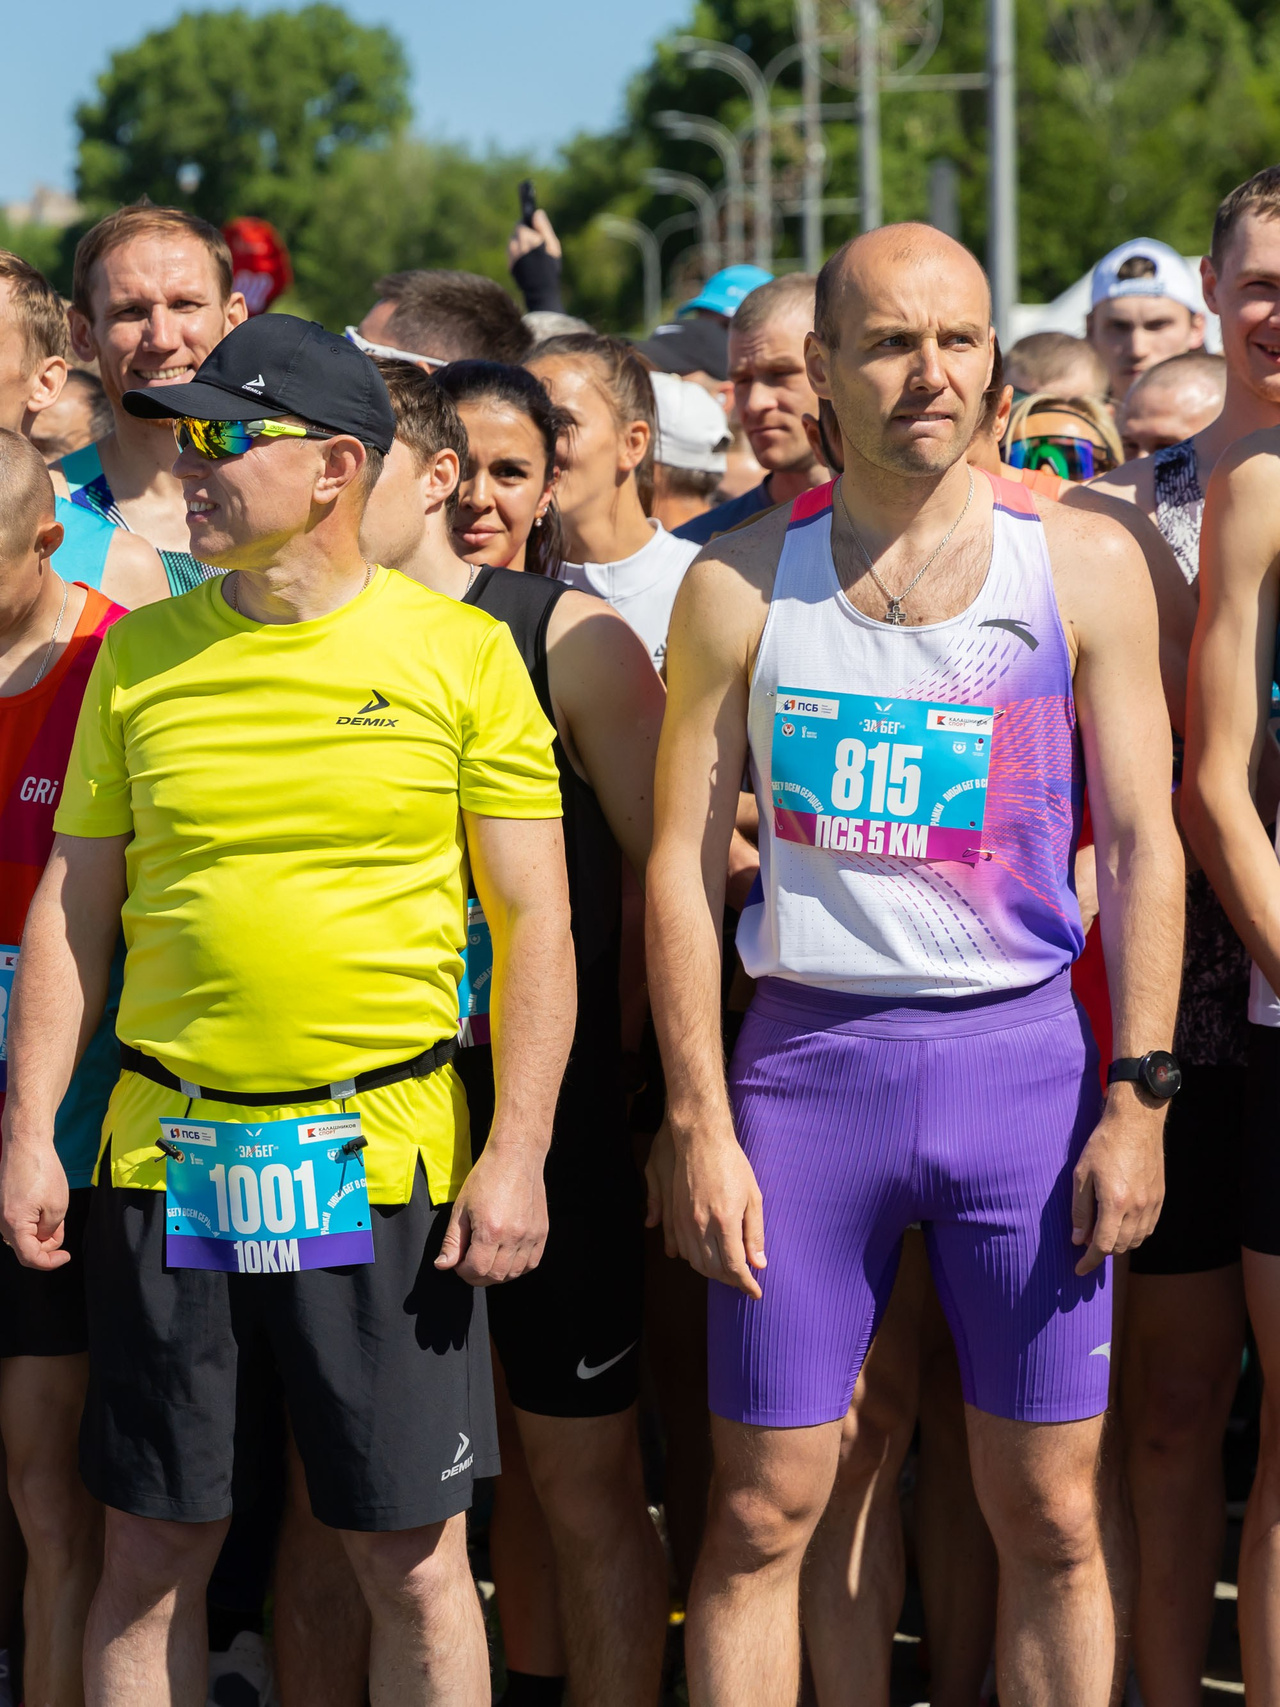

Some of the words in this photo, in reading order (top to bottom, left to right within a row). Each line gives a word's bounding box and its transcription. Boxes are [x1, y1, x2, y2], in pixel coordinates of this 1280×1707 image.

[241, 384, 264, 396] DEMIX
[798, 702, 819, 712] ПСБ
[335, 716, 400, 728] DEMIX
[831, 737, 923, 817] 815
[784, 782, 801, 794] ВСЕМ
[961, 779, 974, 791] БЕГ
[815, 814, 864, 852] ПСБ
[867, 821, 885, 854] 5
[319, 1123, 357, 1132] КАЛАШНИКОВ
[182, 1130, 200, 1140] ПСБ
[342, 1181, 355, 1195] БЕГ
[209, 1160, 319, 1234] 1001
[182, 1208, 197, 1219] ВСЕМ
